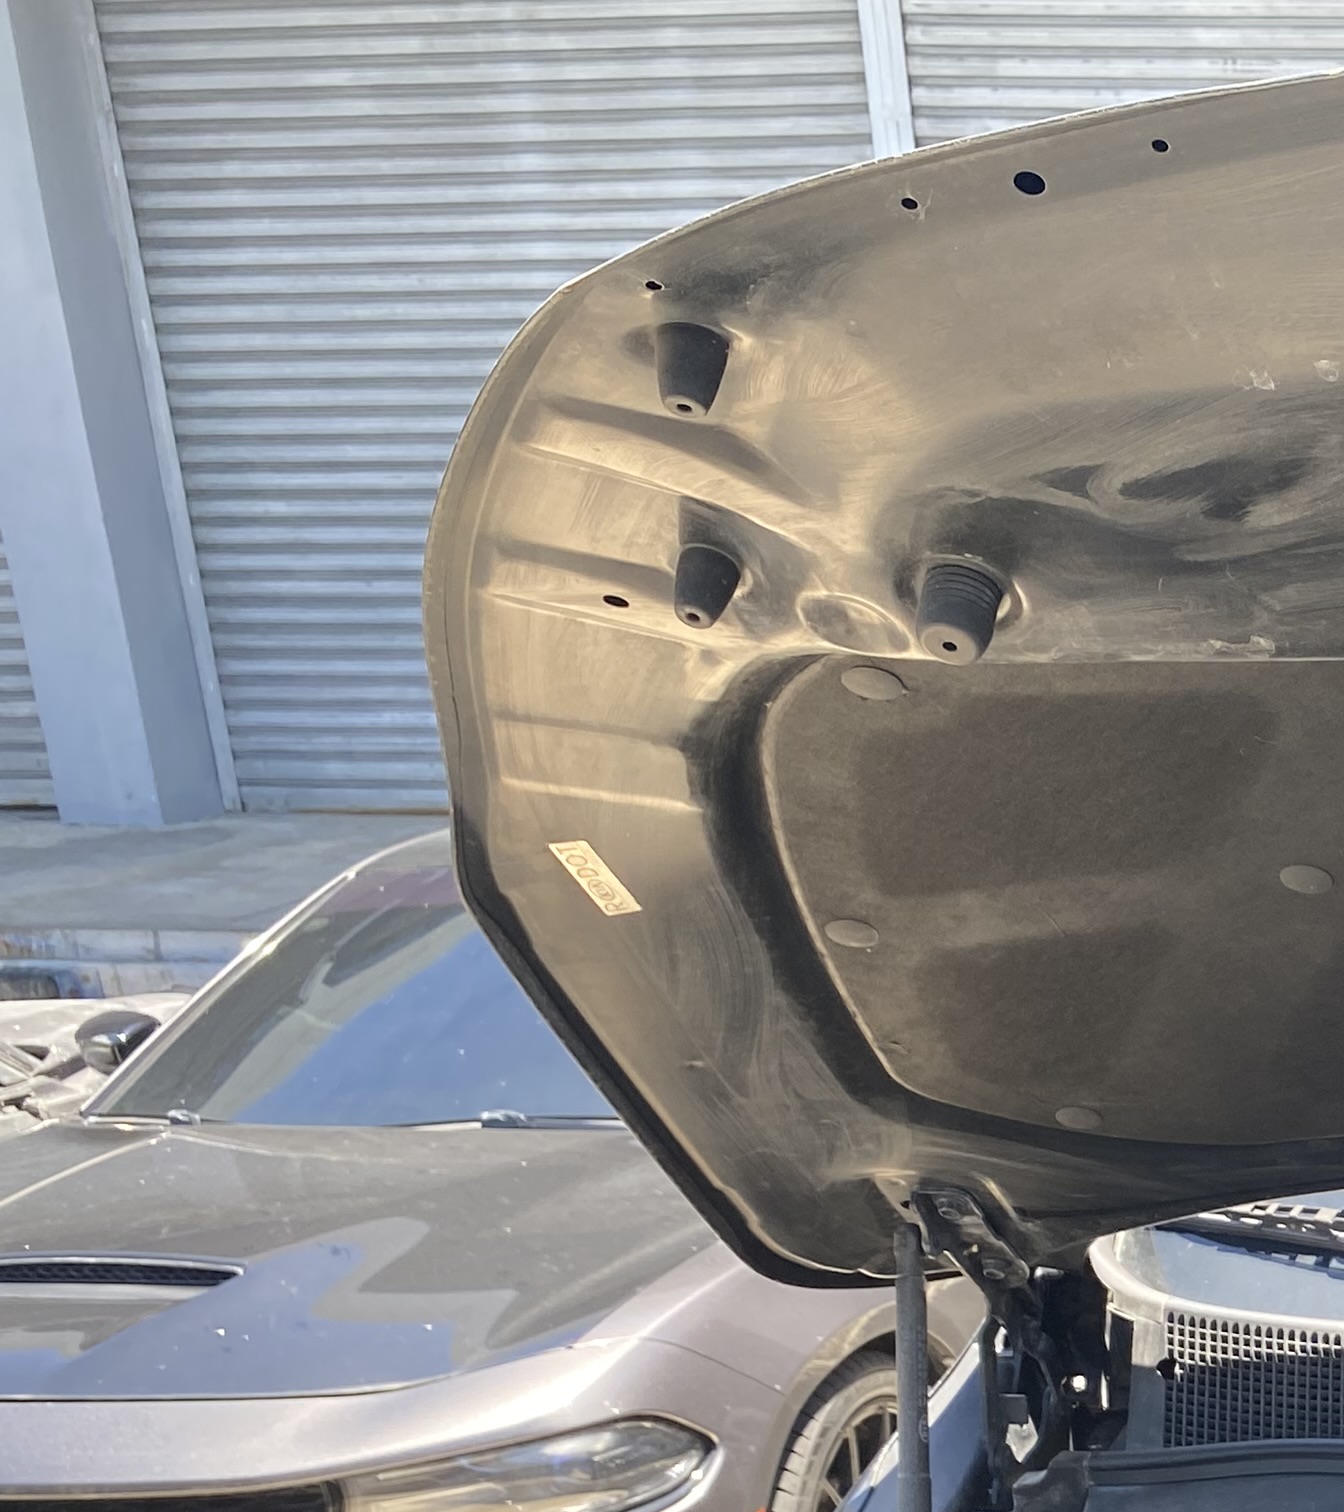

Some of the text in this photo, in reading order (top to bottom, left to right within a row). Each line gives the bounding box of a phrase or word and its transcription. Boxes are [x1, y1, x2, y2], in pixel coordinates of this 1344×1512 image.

[556, 847, 599, 878] DOT
[590, 881, 613, 899] KIA
[605, 903, 628, 912] R
